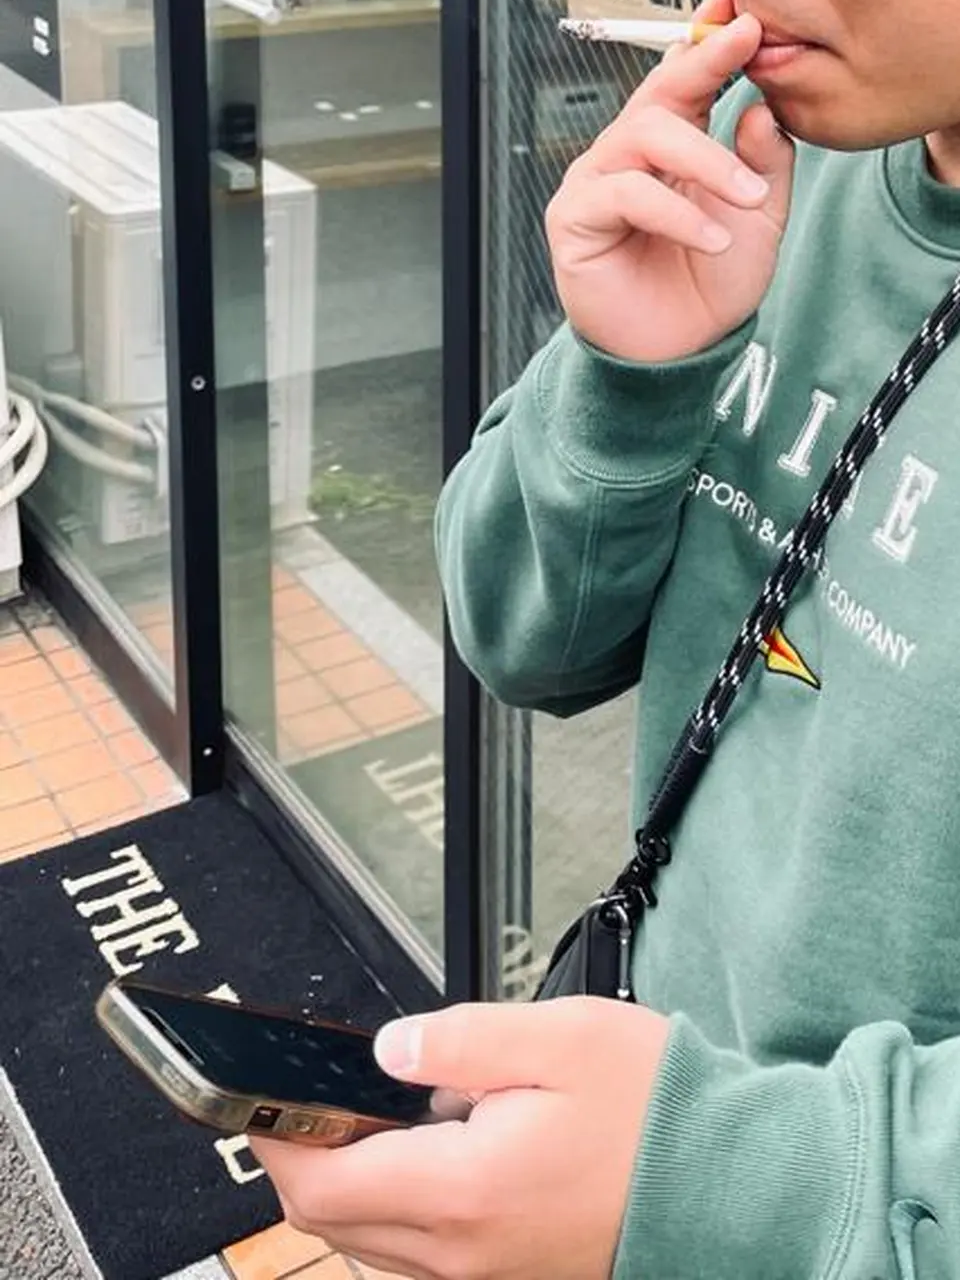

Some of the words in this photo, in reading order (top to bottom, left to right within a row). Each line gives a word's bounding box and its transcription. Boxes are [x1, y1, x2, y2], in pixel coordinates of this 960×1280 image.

[714, 341, 939, 564] NIE
[827, 580, 917, 669] COMPANY
[61, 844, 200, 977] THE
